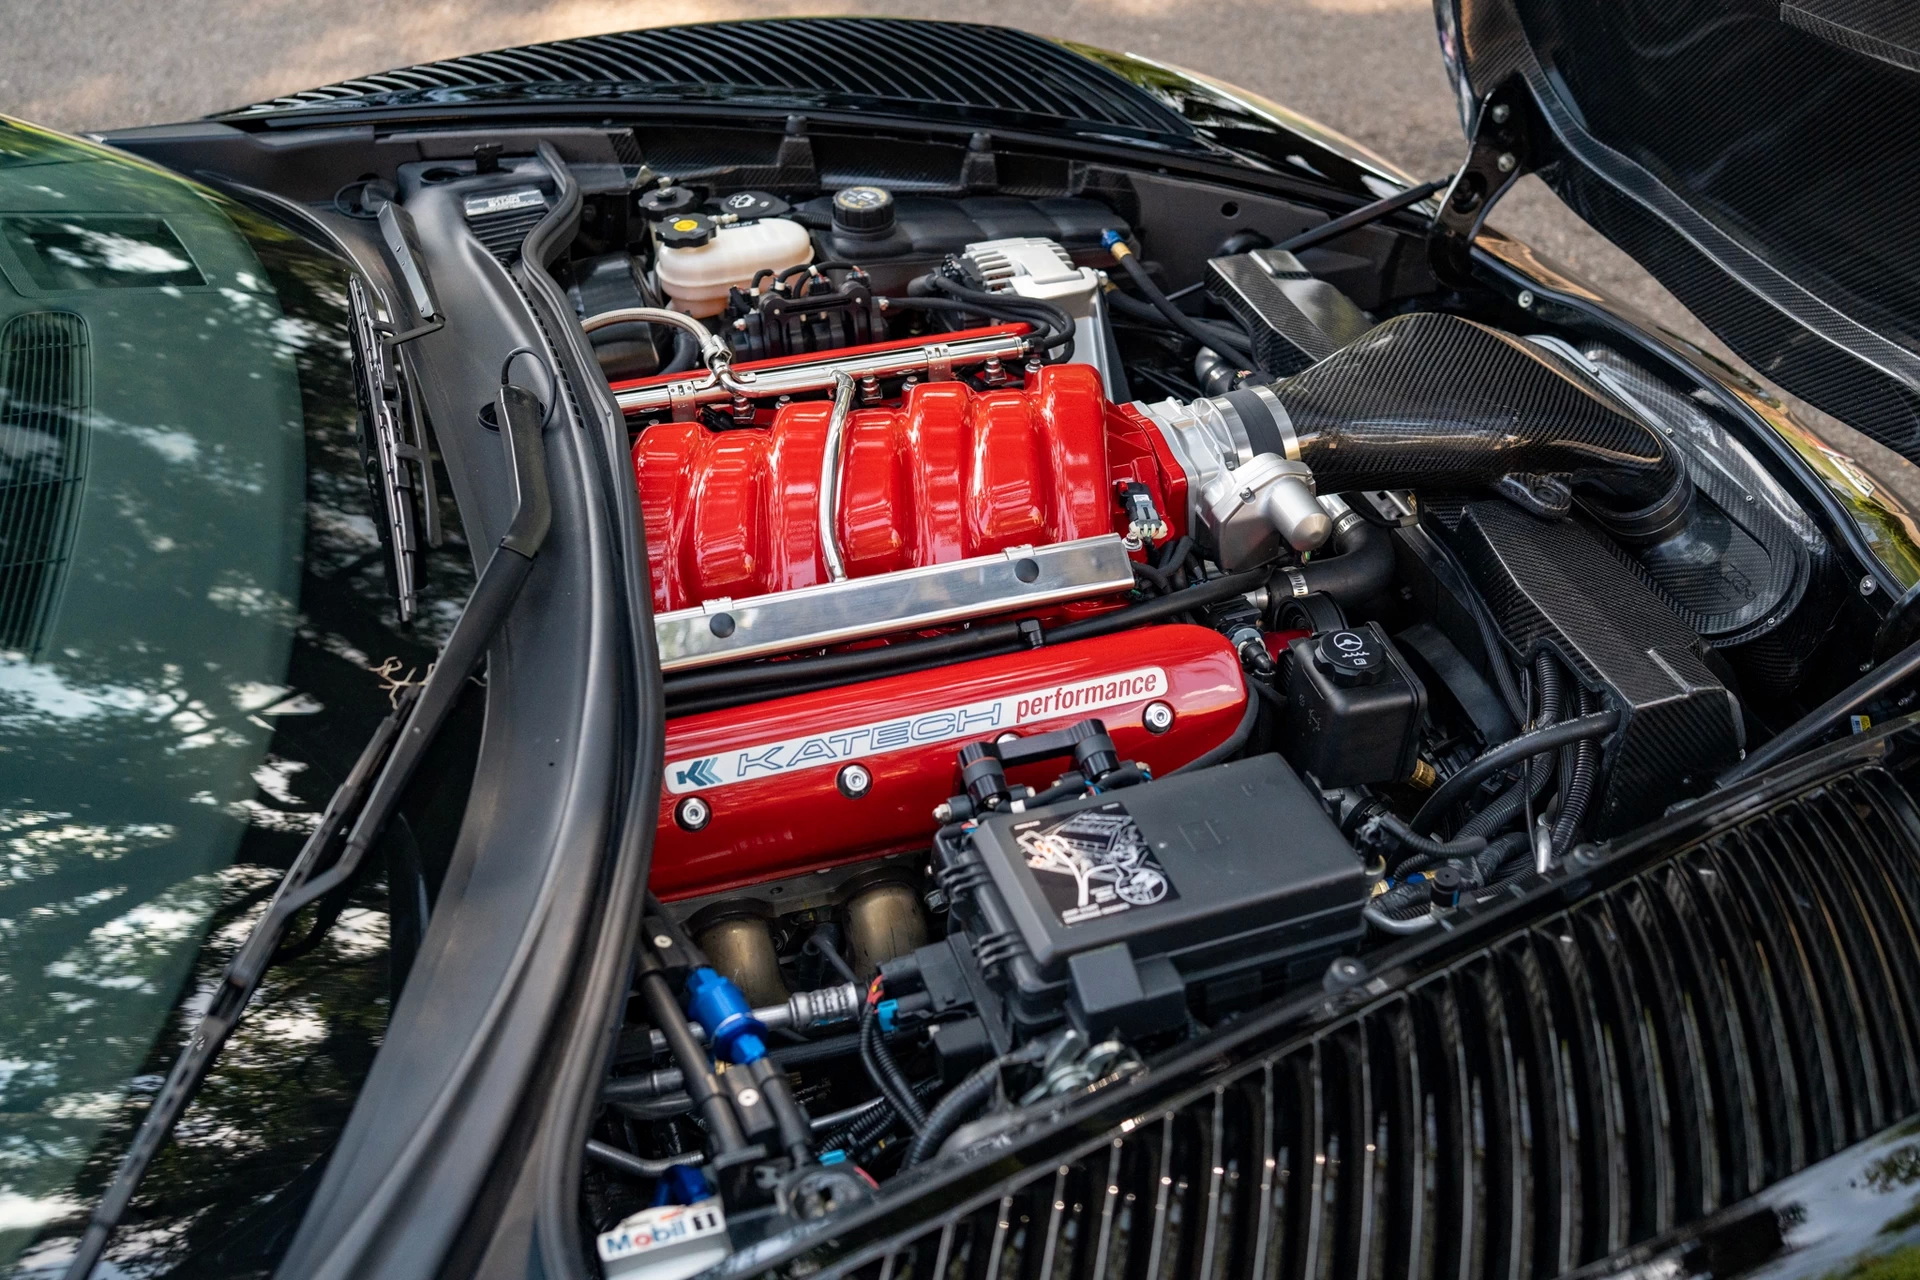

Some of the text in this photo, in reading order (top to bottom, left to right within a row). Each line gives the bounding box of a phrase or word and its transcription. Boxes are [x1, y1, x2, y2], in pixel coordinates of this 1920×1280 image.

[737, 672, 1157, 777] KATECH performance
[606, 1219, 686, 1253] Mobil
